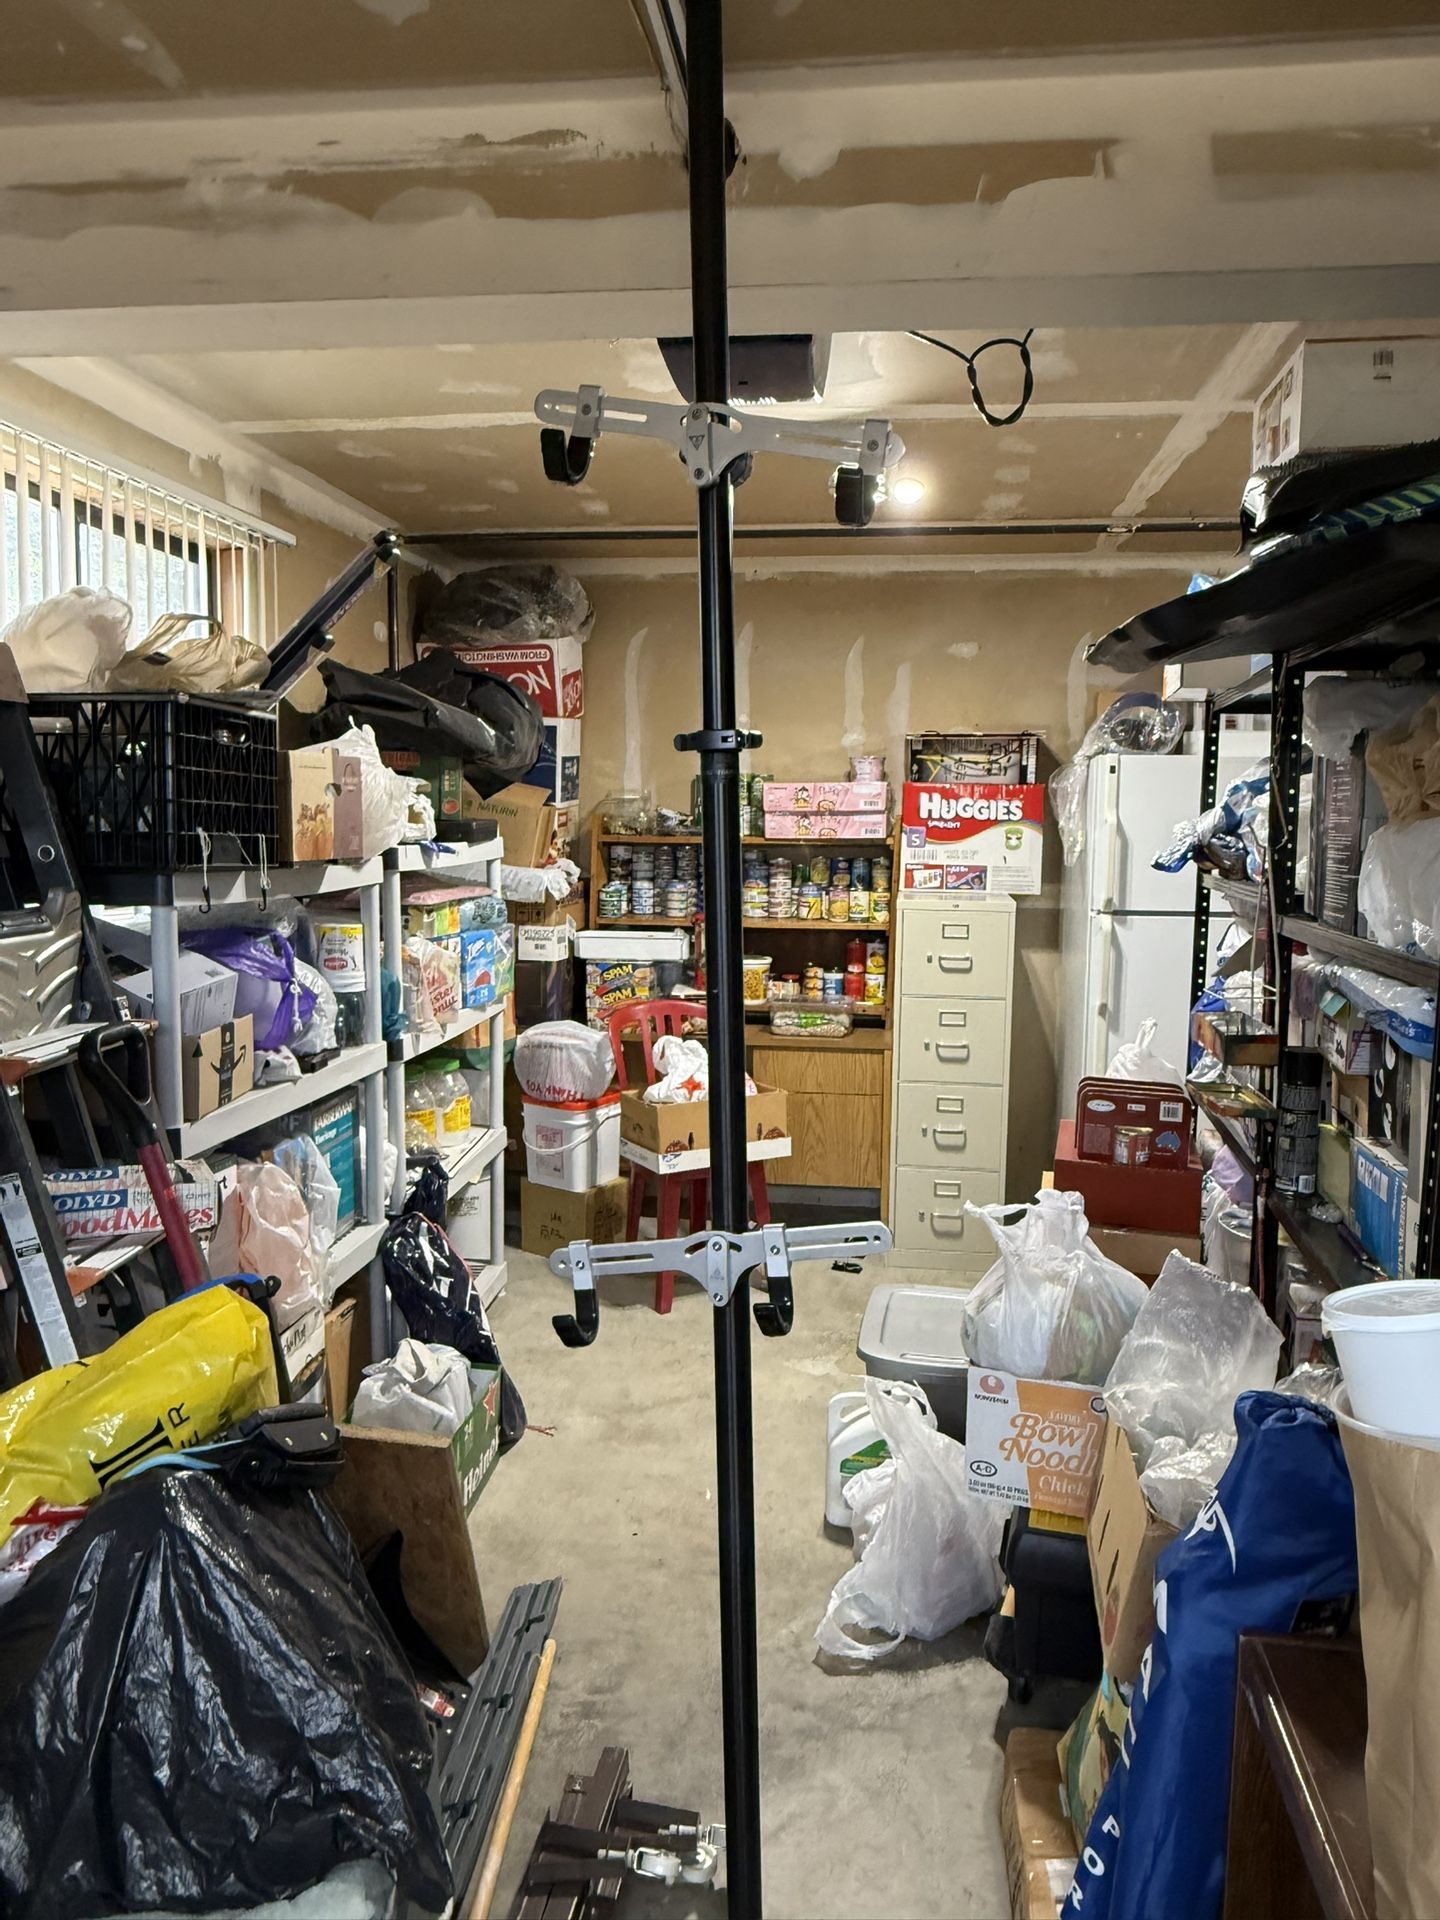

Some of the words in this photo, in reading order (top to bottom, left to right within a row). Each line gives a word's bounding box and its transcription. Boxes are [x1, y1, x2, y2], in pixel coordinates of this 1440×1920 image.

[918, 791, 1023, 822] HUGGIES
[911, 835, 921, 846] 5
[602, 964, 634, 981] SPAM
[602, 987, 633, 1004] SPAM
[44, 1169, 113, 1181] OLY-D
[53, 1193, 121, 1211] OLY-D
[1009, 1412, 1098, 1449] Bowl
